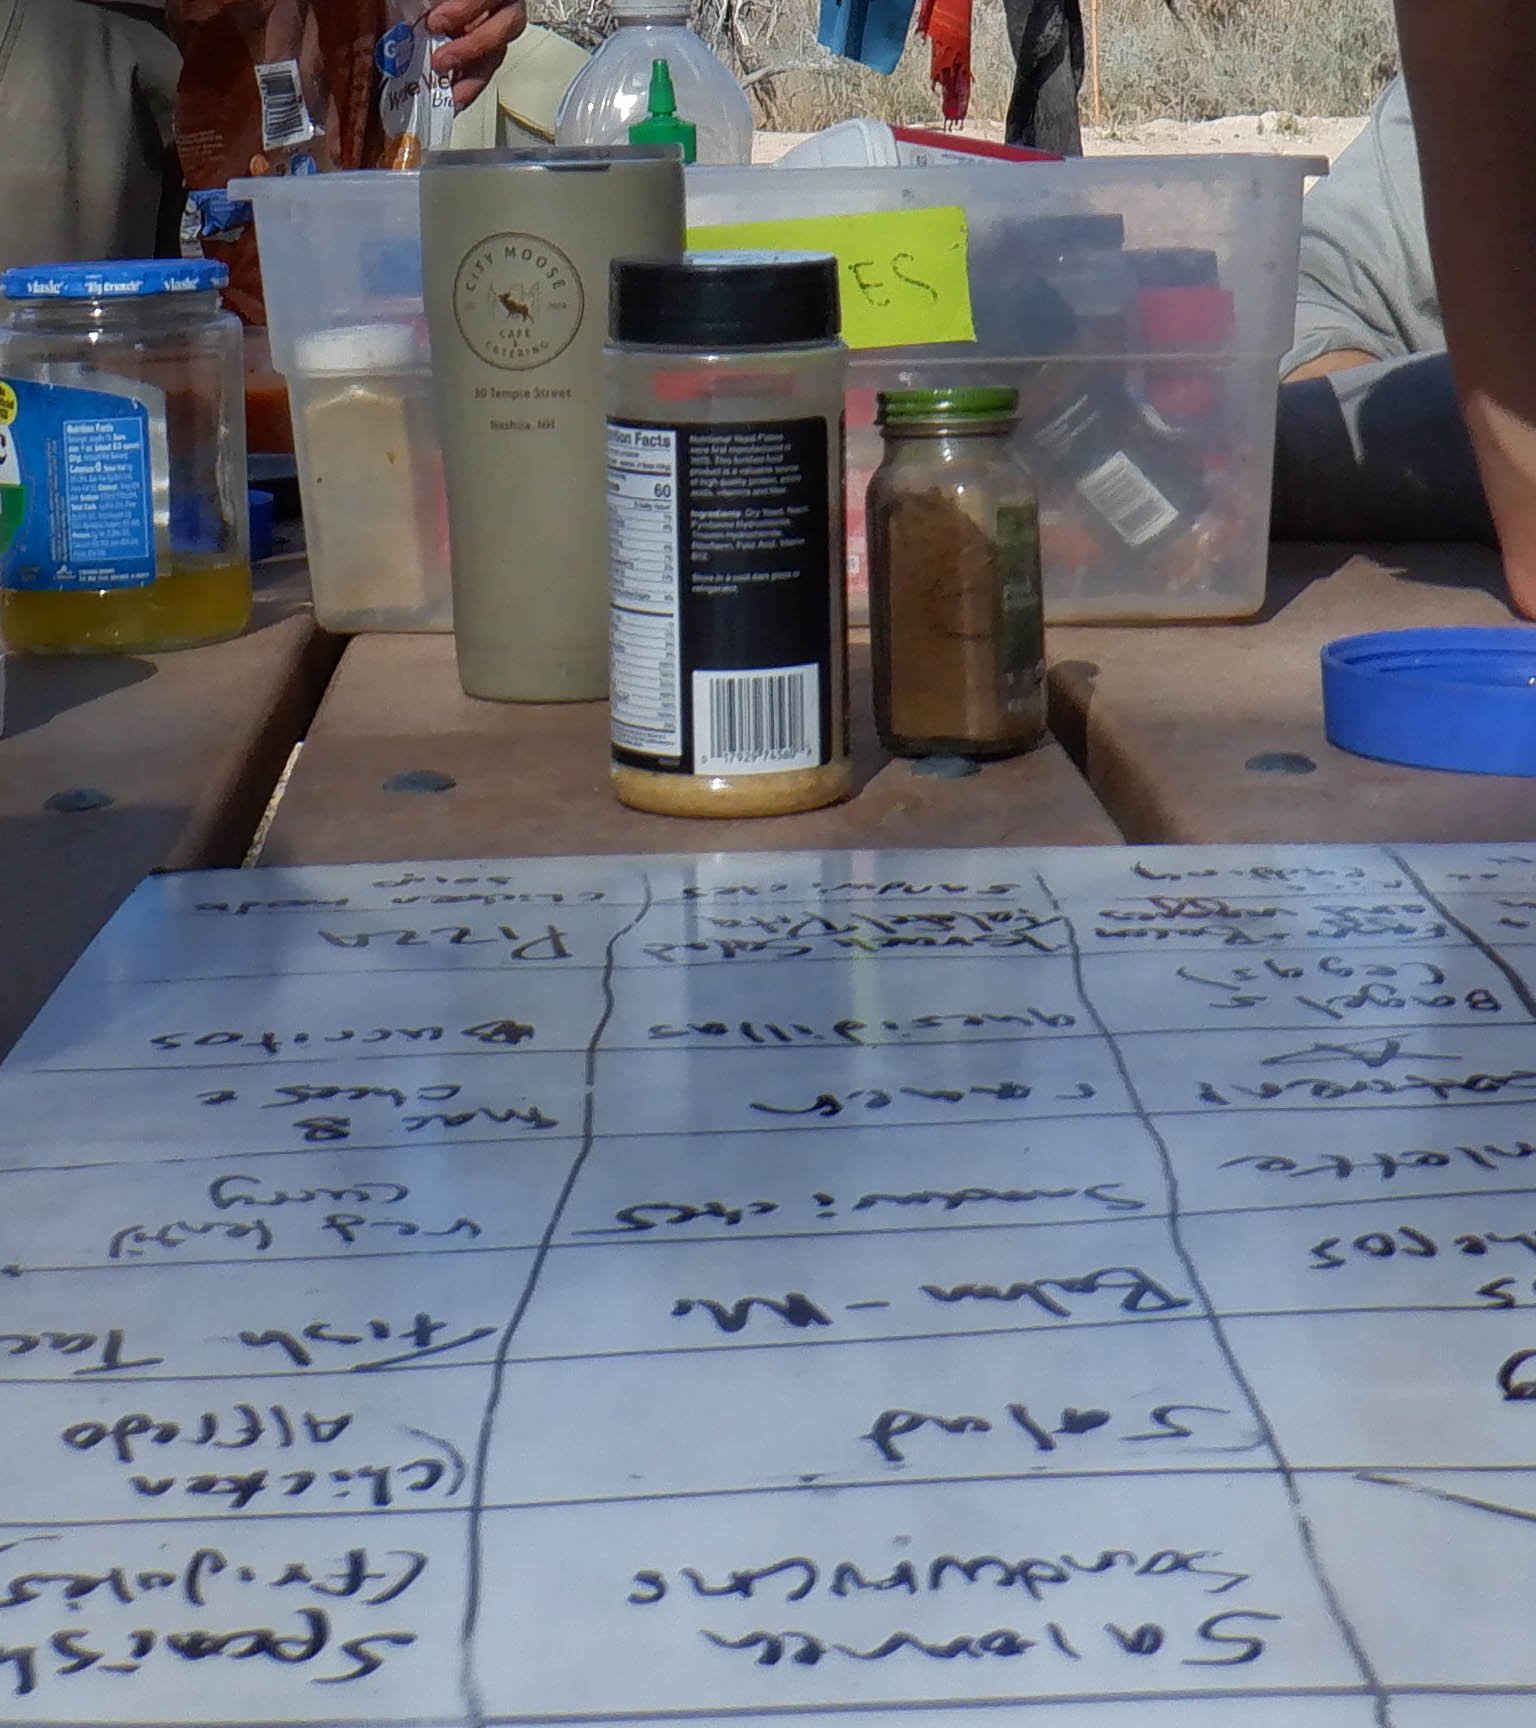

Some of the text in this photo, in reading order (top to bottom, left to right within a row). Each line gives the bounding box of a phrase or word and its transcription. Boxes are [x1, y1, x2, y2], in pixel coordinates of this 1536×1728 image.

[465, 246, 567, 293] CITY MOOSE
[849, 252, 939, 308] ES
[485, 339, 550, 360] CATERING
[490, 387, 531, 401] Temple
[533, 387, 572, 399] Street
[634, 430, 672, 448] Facts
[654, 483, 672, 498] 60
[207, 1175, 410, 1211] curry
